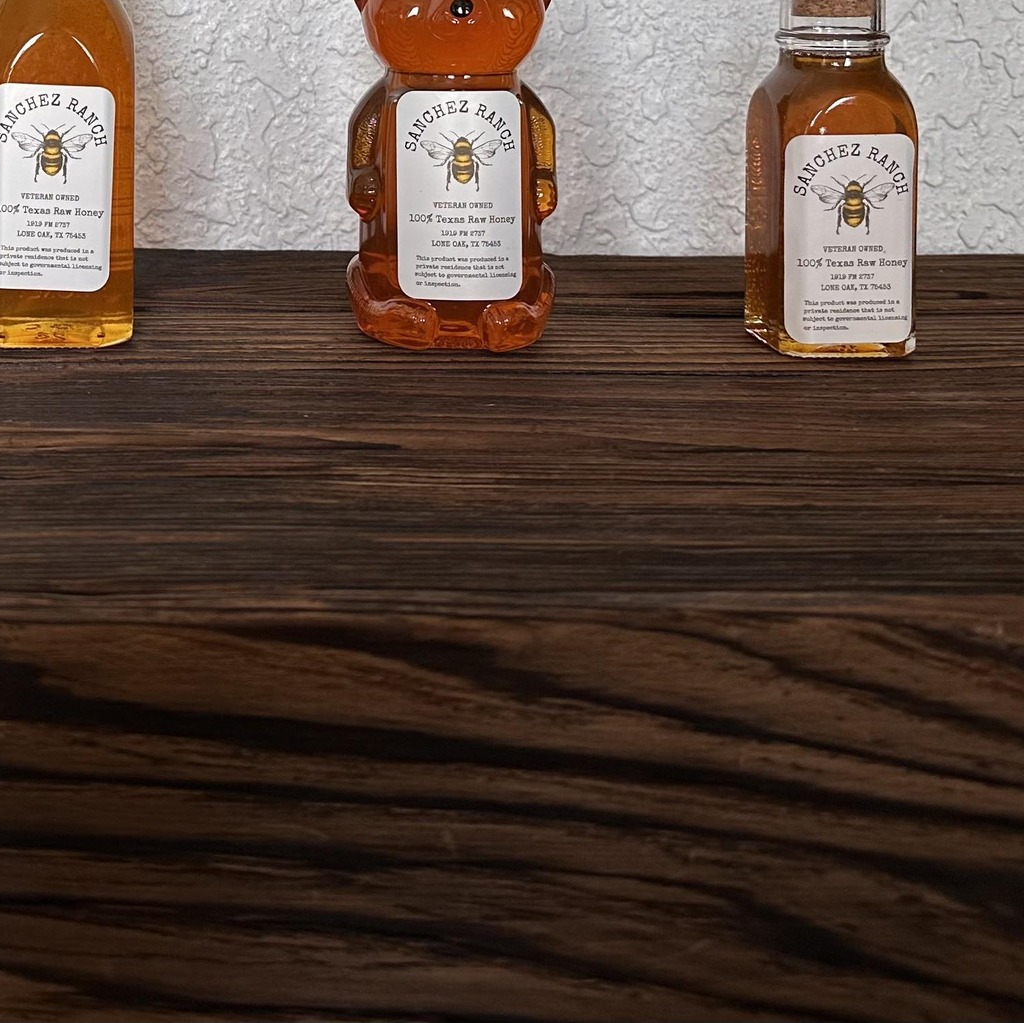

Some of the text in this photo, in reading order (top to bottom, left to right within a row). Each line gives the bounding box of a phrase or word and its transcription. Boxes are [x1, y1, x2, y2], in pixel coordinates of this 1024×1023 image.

[66, 97, 107, 146] RANCH
[405, 100, 515, 152] SANCHEZ RANCH
[794, 143, 860, 196] SANCHEZ
[867, 147, 909, 195] RANCH
[22, 206, 51, 215] Texas
[54, 207, 72, 215] Raw
[75, 208, 104, 218] Honey
[409, 213, 433, 224] 100%
[436, 215, 465, 223] Texas
[489, 215, 515, 224] Honey
[797, 258, 908, 268] 100% Texas Raw Honey
